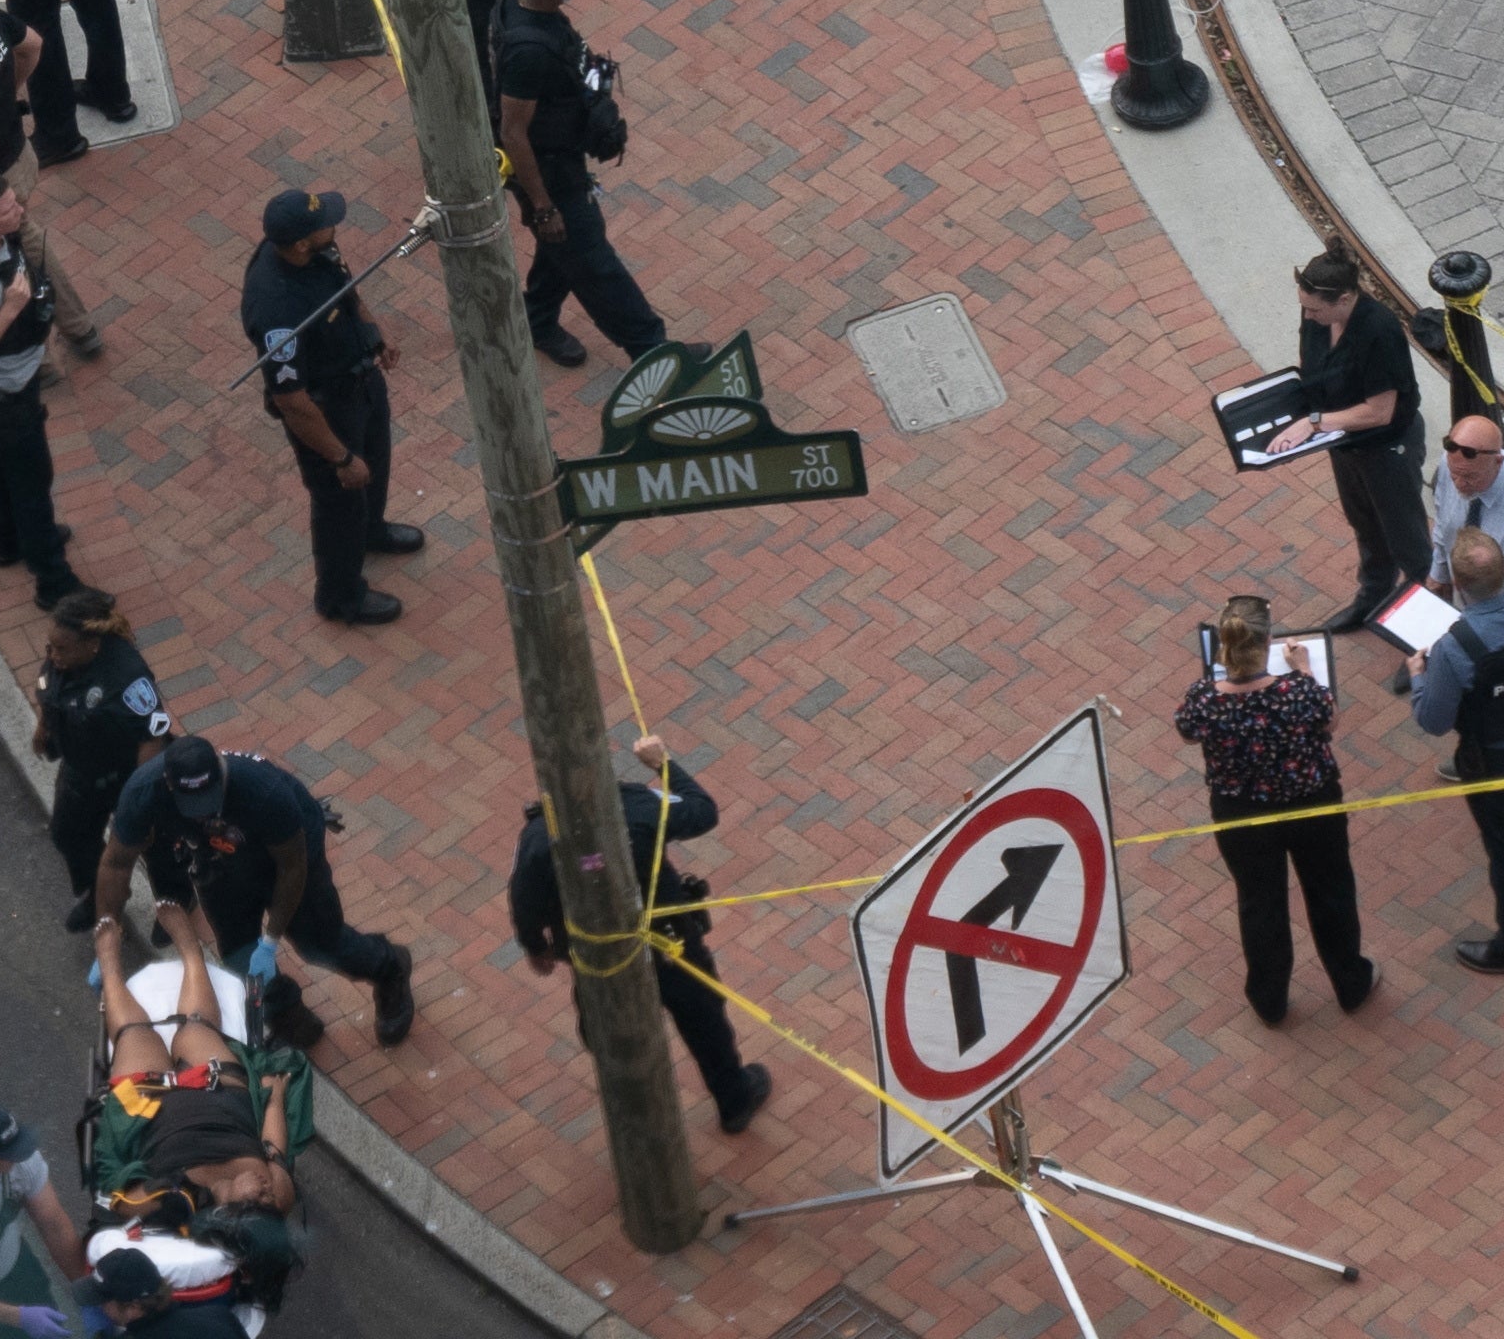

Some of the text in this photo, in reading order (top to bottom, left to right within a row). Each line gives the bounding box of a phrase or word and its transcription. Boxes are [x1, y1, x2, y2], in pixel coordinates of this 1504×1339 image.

[720, 350, 740, 383] ST
[579, 445, 832, 510] W MAIN ST
[790, 466, 838, 489] 700
